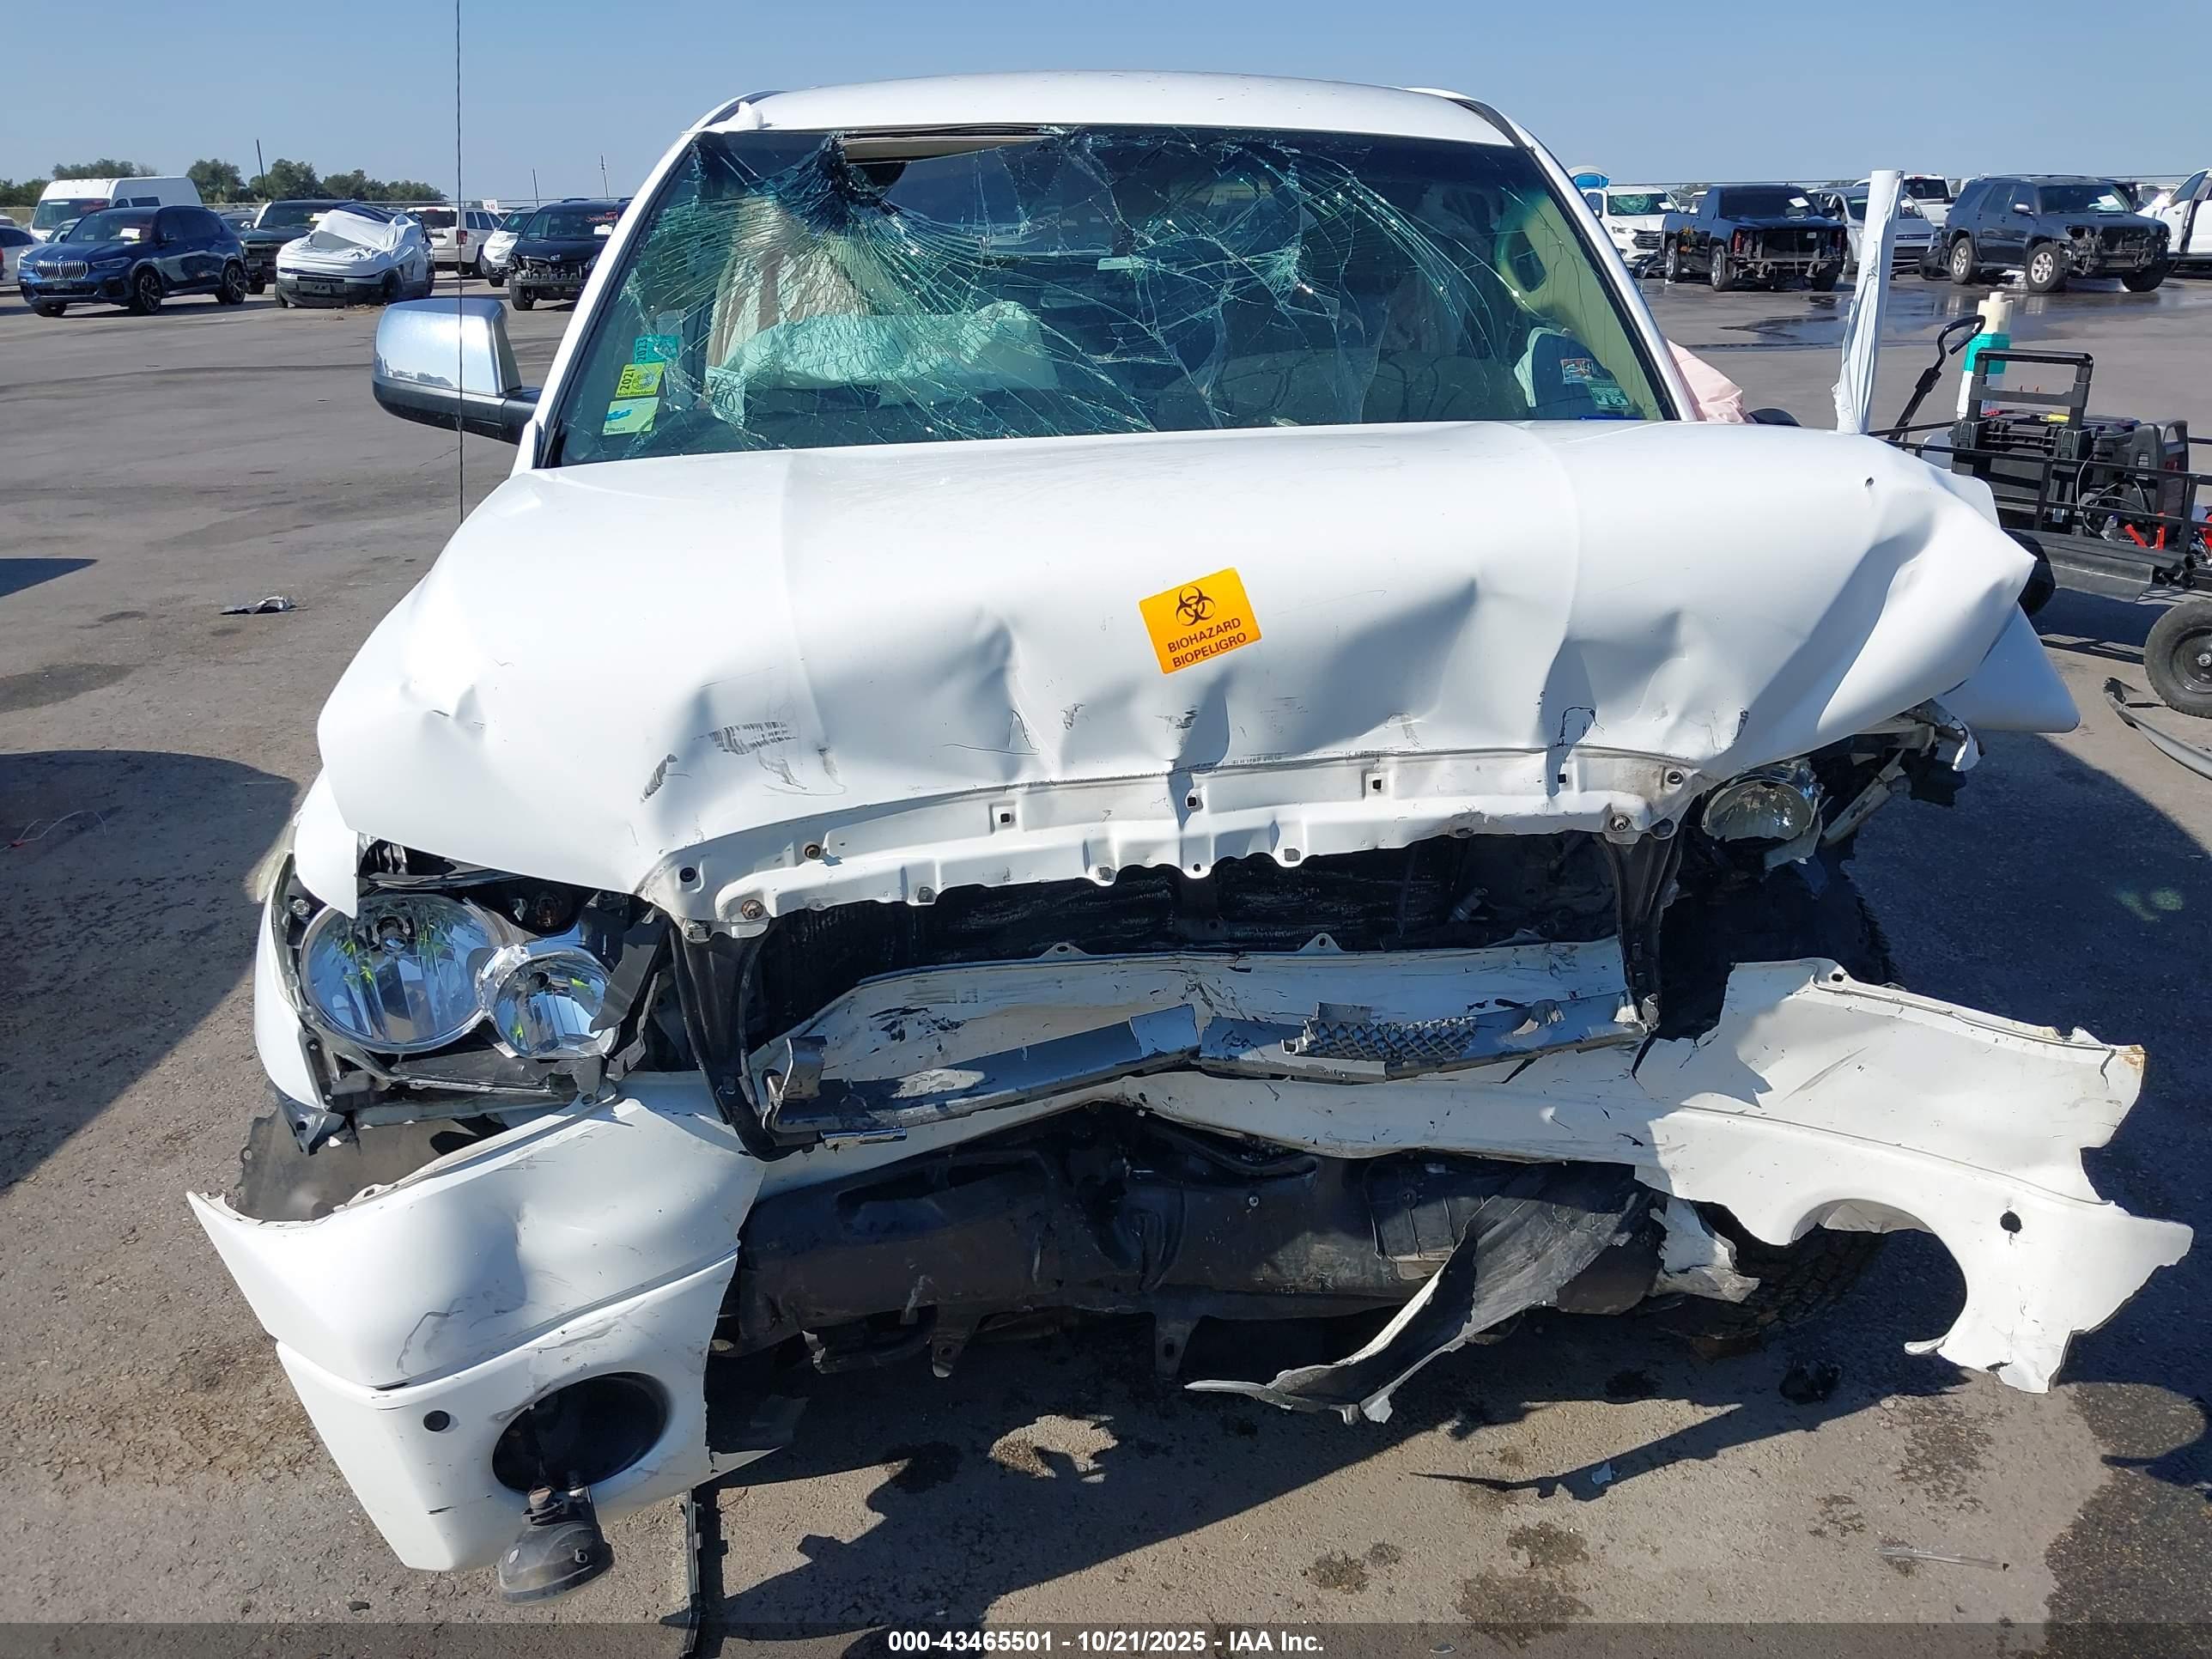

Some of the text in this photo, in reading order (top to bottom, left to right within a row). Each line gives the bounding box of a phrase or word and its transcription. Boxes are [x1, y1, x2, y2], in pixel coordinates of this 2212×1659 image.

[635, 338, 648, 362] 2023
[619, 368, 635, 391] 2021
[1168, 617, 1242, 653] BIOHAZARD
[1172, 633, 1247, 668] BIOPELIGRO
